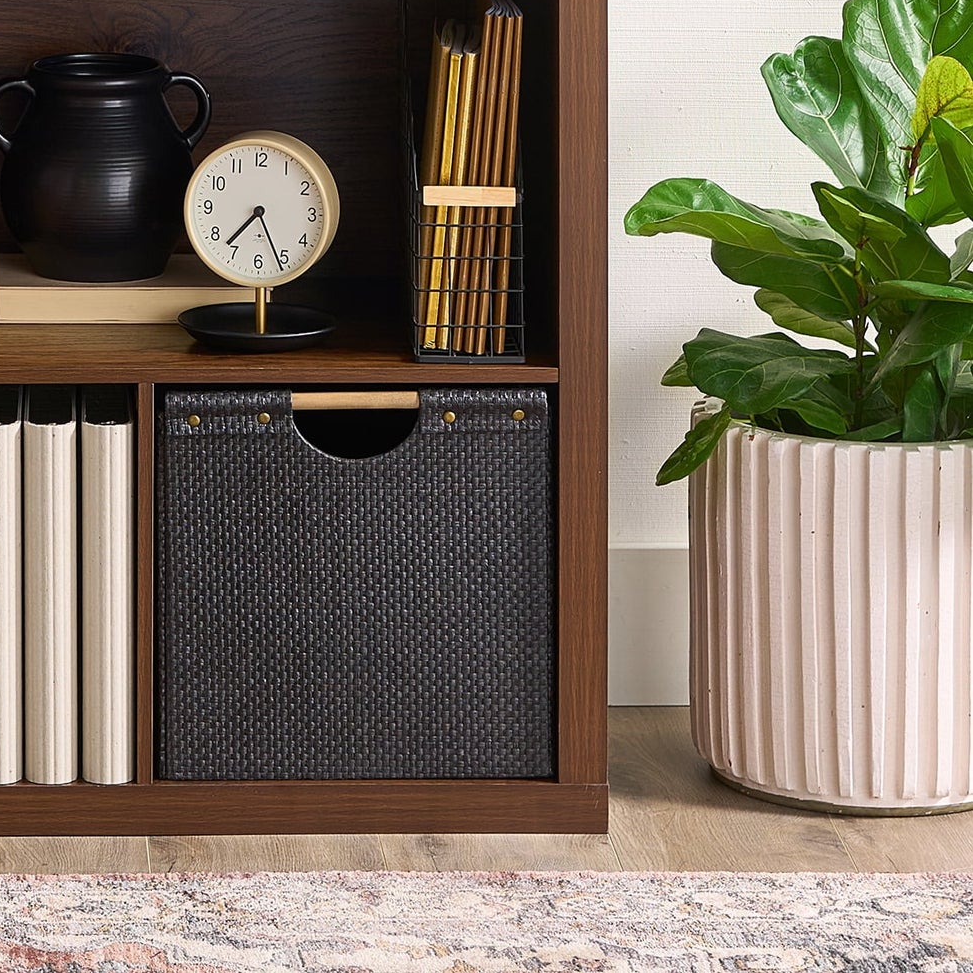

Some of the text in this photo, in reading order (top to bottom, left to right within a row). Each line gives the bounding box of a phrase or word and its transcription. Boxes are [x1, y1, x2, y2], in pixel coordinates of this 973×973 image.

[232, 159, 241, 173] 11
[255, 152, 267, 167] 12
[212, 176, 225, 191] 10
[300, 181, 310, 195] 2
[204, 200, 212, 214] 9
[308, 208, 316, 222] 3
[211, 227, 220, 241] 8
[299, 233, 307, 247] 4
[230, 246, 239, 259] 7
[280, 250, 289, 264] 5
[254, 254, 263, 269] 6
